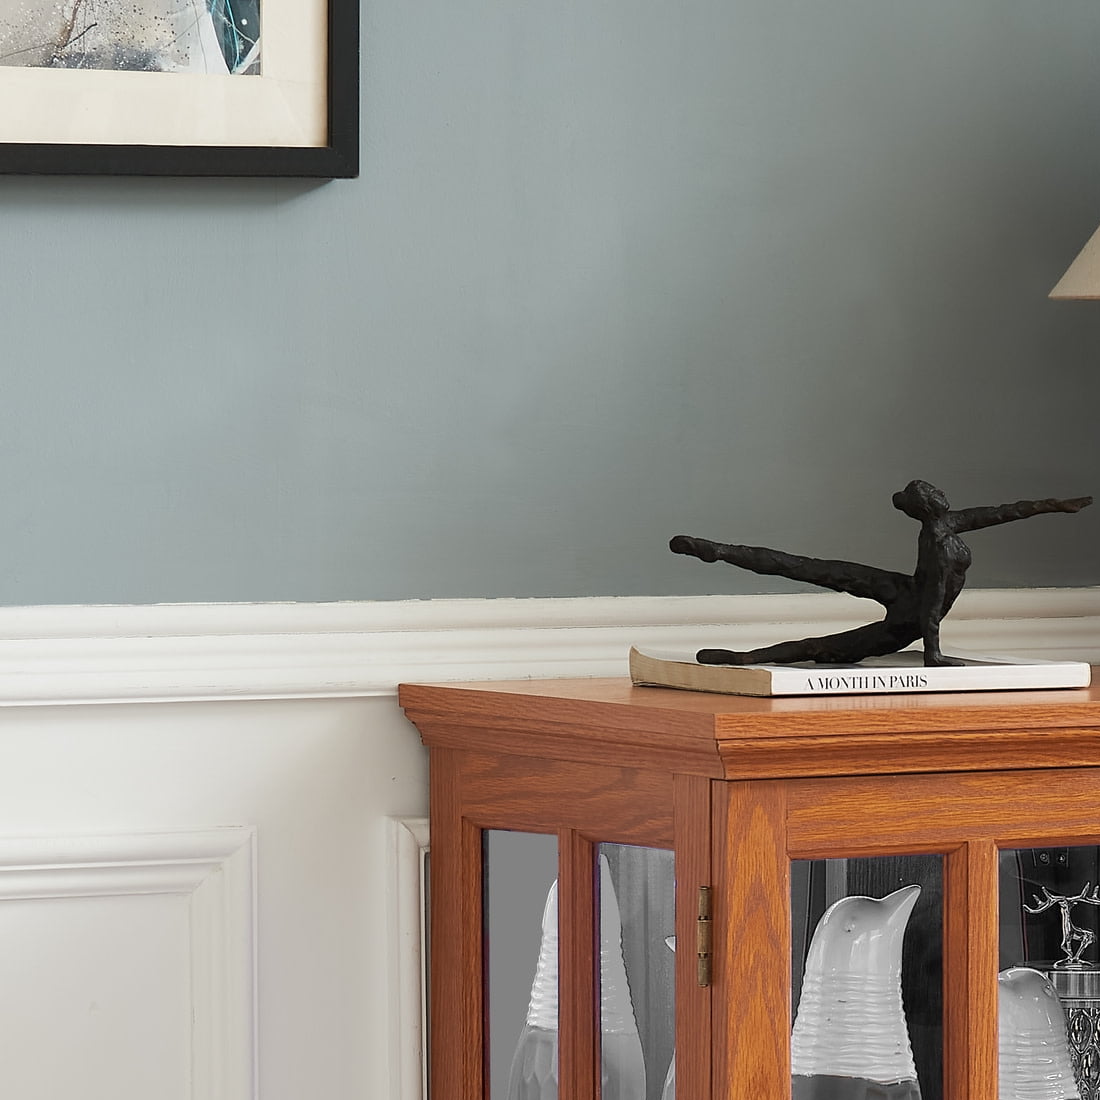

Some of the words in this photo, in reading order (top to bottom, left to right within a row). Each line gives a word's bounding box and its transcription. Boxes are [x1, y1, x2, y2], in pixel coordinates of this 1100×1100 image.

[804, 678, 814, 690] A
[818, 676, 869, 690] MONTH
[873, 676, 886, 689] IN
[889, 674, 928, 688] PARIS
